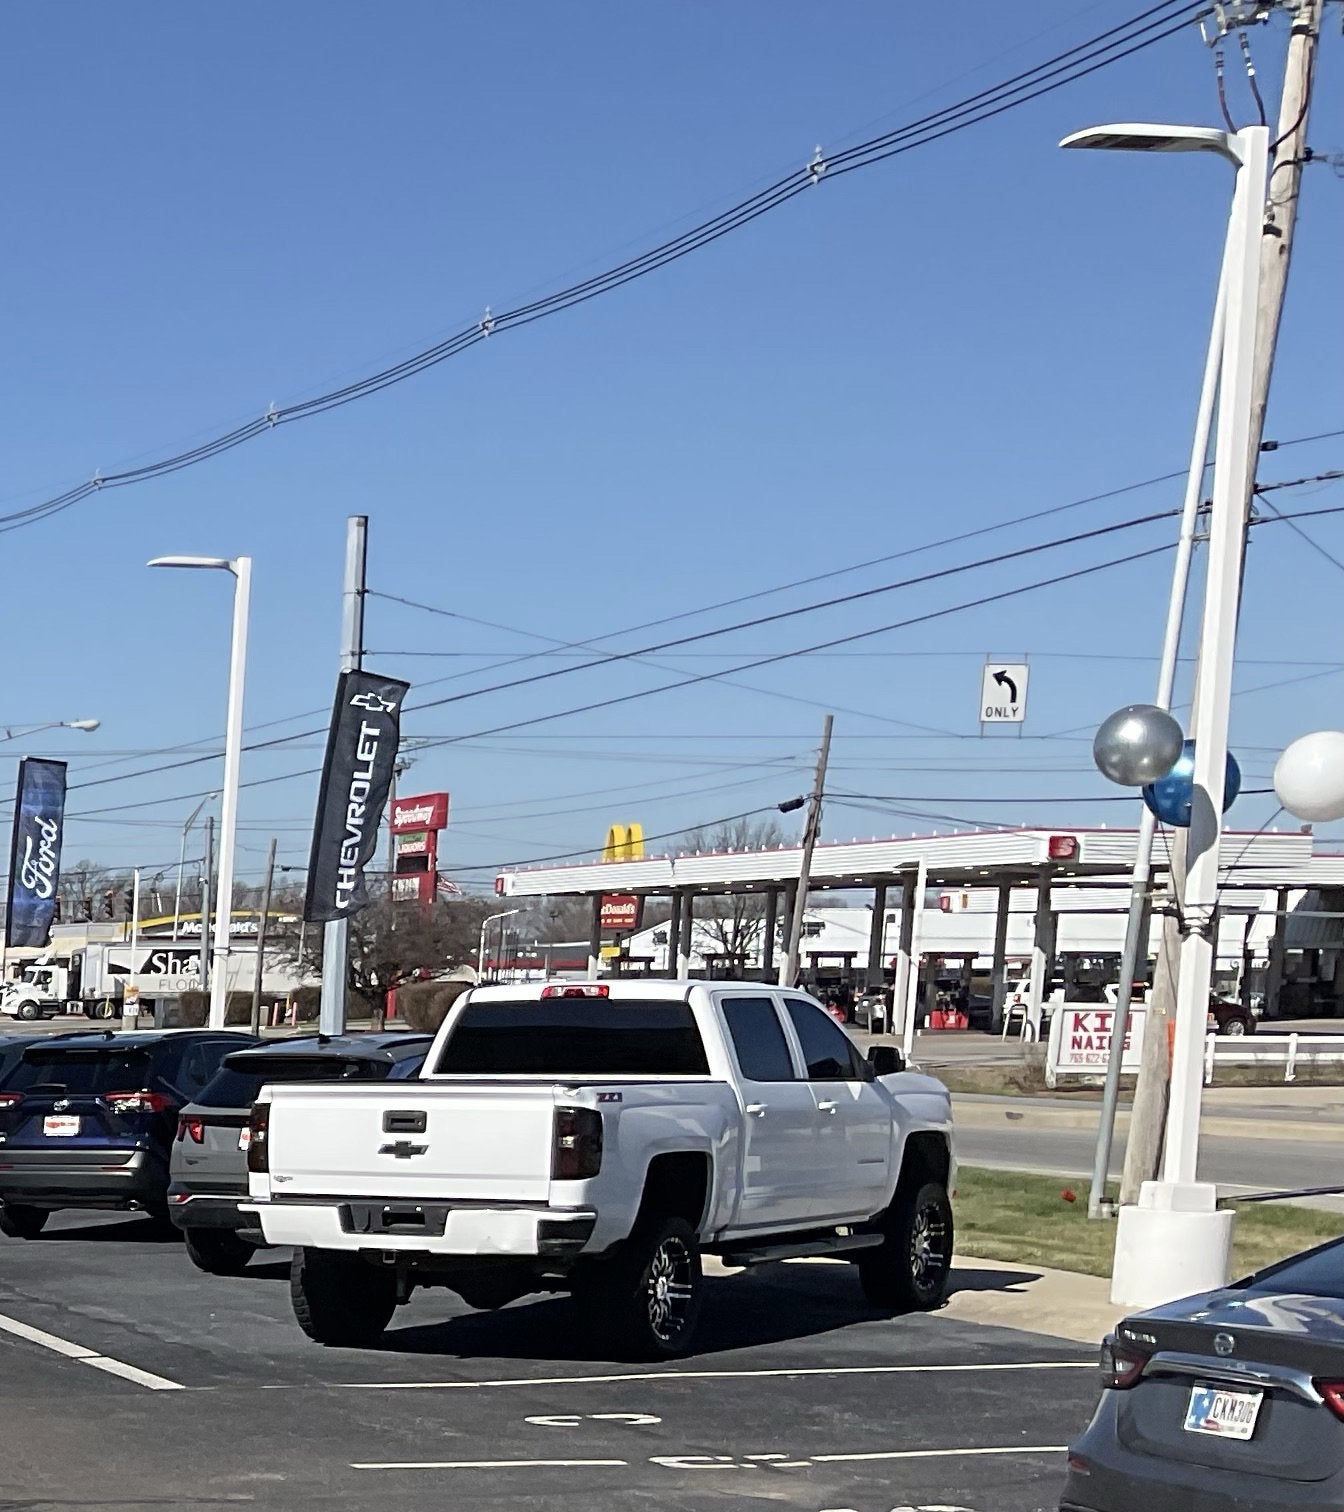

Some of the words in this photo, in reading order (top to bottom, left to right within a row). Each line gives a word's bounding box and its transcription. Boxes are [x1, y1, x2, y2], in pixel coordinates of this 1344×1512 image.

[985, 706, 1019, 718] ONLY
[335, 720, 381, 909] CHEVROLET
[21, 815, 58, 899] Ford
